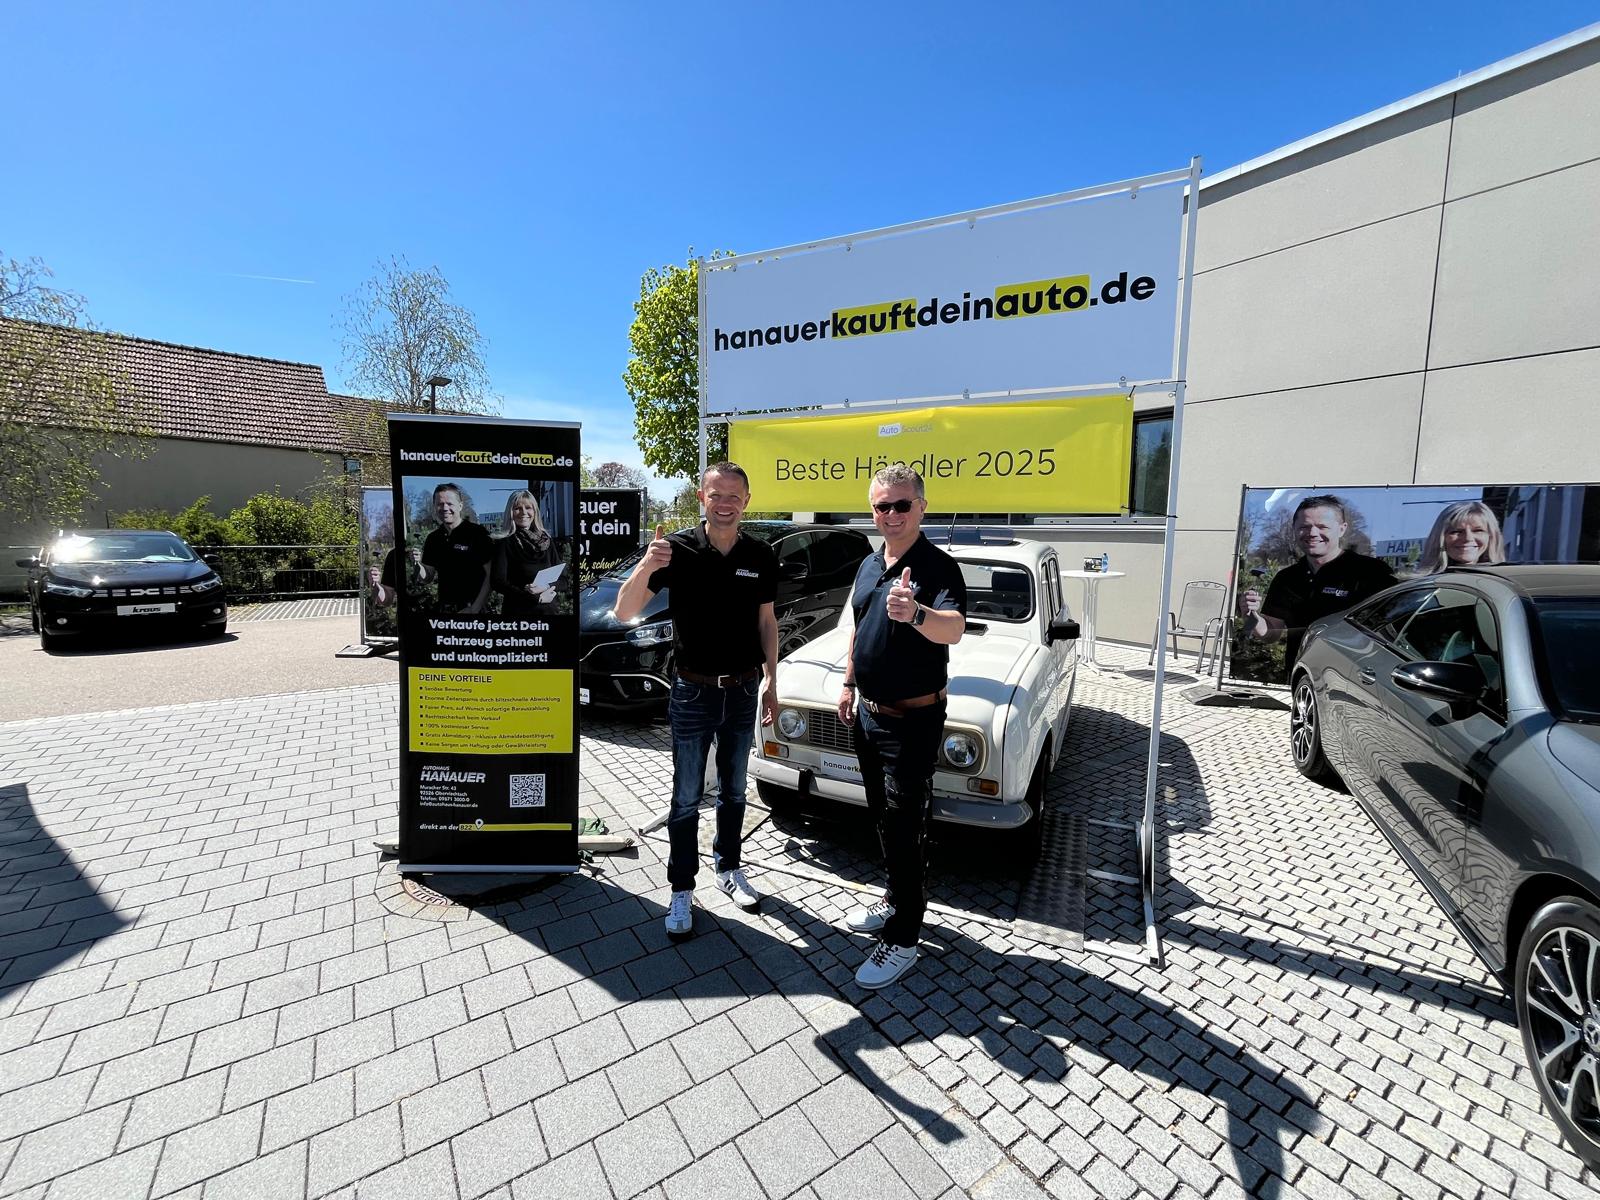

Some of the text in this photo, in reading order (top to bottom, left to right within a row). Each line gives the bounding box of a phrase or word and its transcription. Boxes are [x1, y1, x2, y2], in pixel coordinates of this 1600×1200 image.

[714, 272, 1156, 351] hanauerkauftdeinauto.de
[400, 449, 574, 467] hanauerkauftdeinauto.de
[776, 448, 1056, 481] Beste Hädler 2025
[591, 519, 631, 535] dein
[429, 619, 550, 633] Verkaufe jetzt Dein
[436, 635, 543, 649] Fahrzeug schnell
[431, 651, 548, 665] und unkompliziert!
[418, 673, 493, 683] DEINE VORTEILE
[823, 760, 860, 772] hanauerk
[420, 770, 486, 783] HANAUER
